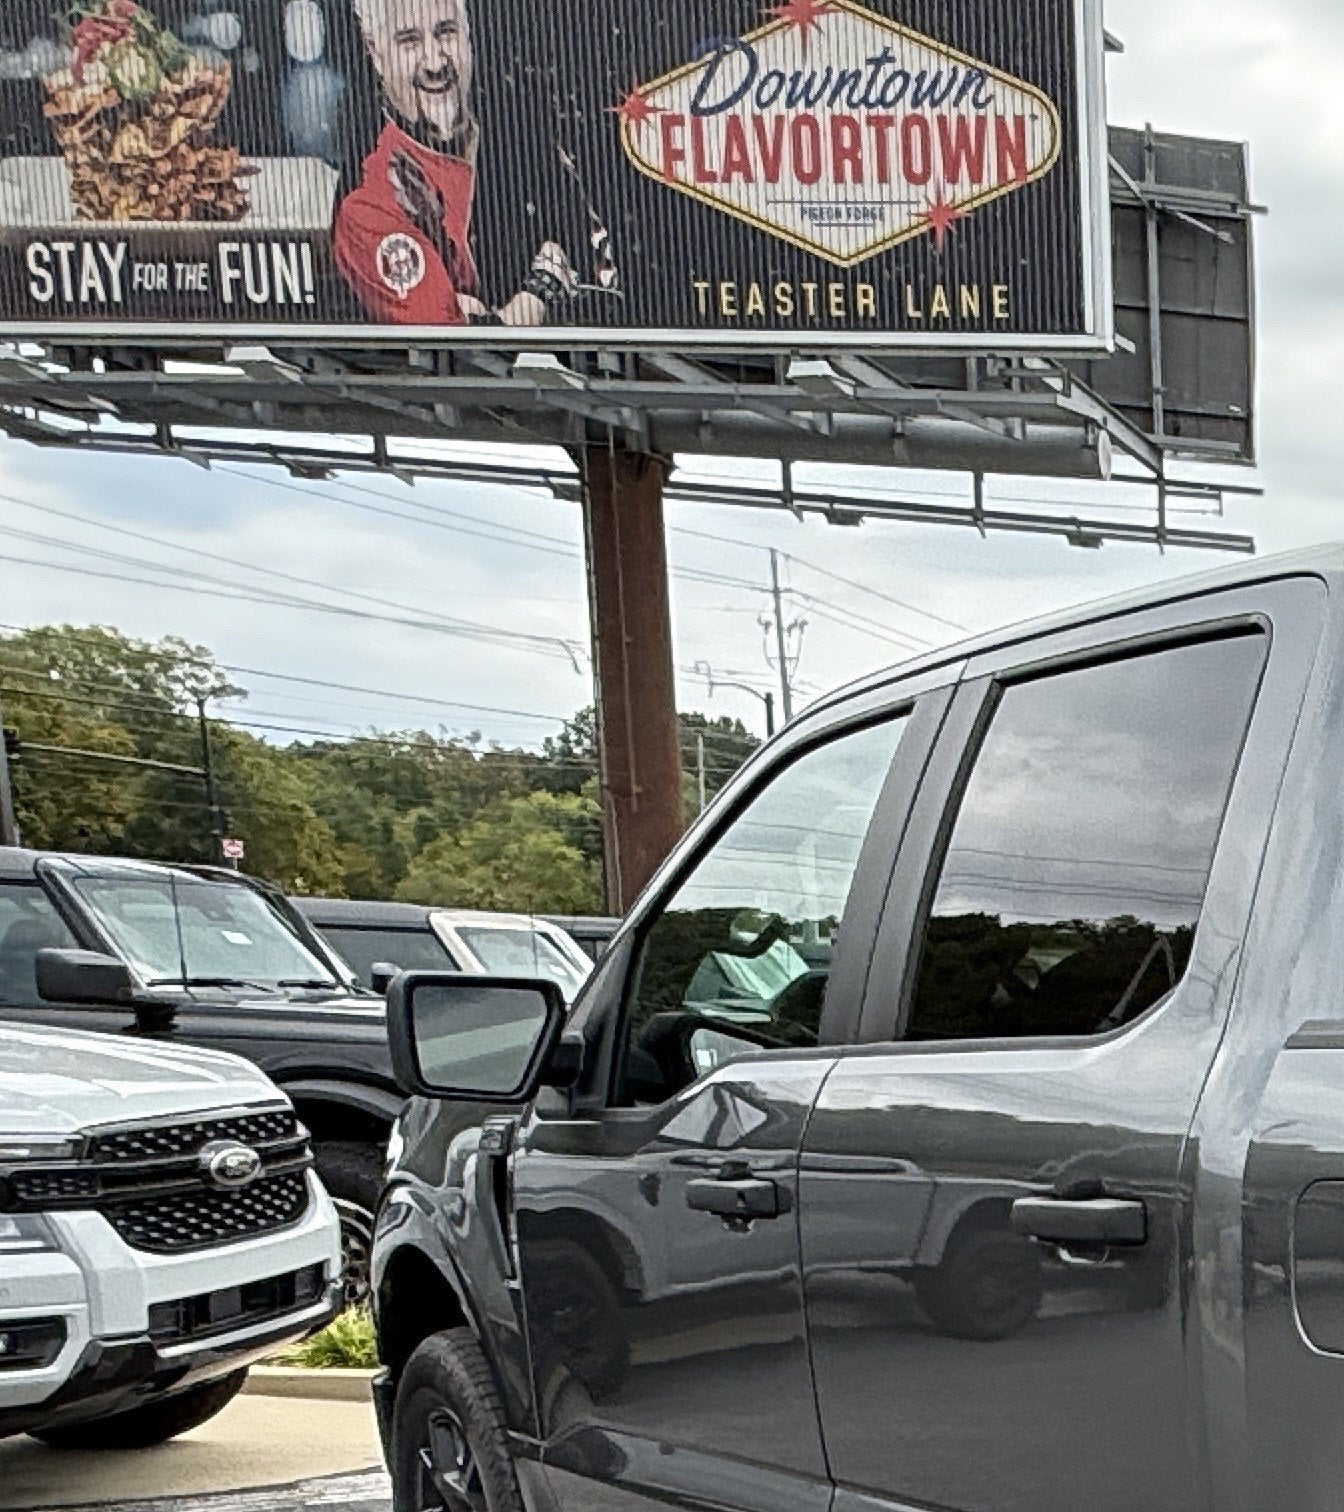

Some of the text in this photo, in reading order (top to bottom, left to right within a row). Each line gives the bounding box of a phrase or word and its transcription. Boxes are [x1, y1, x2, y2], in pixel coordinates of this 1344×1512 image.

[691, 35, 994, 117] Downtown
[660, 112, 1027, 185] FLAVORTOWN
[26, 242, 316, 304] STAY FOR THE FUN!
[694, 282, 1010, 318] TEASTER LANE
